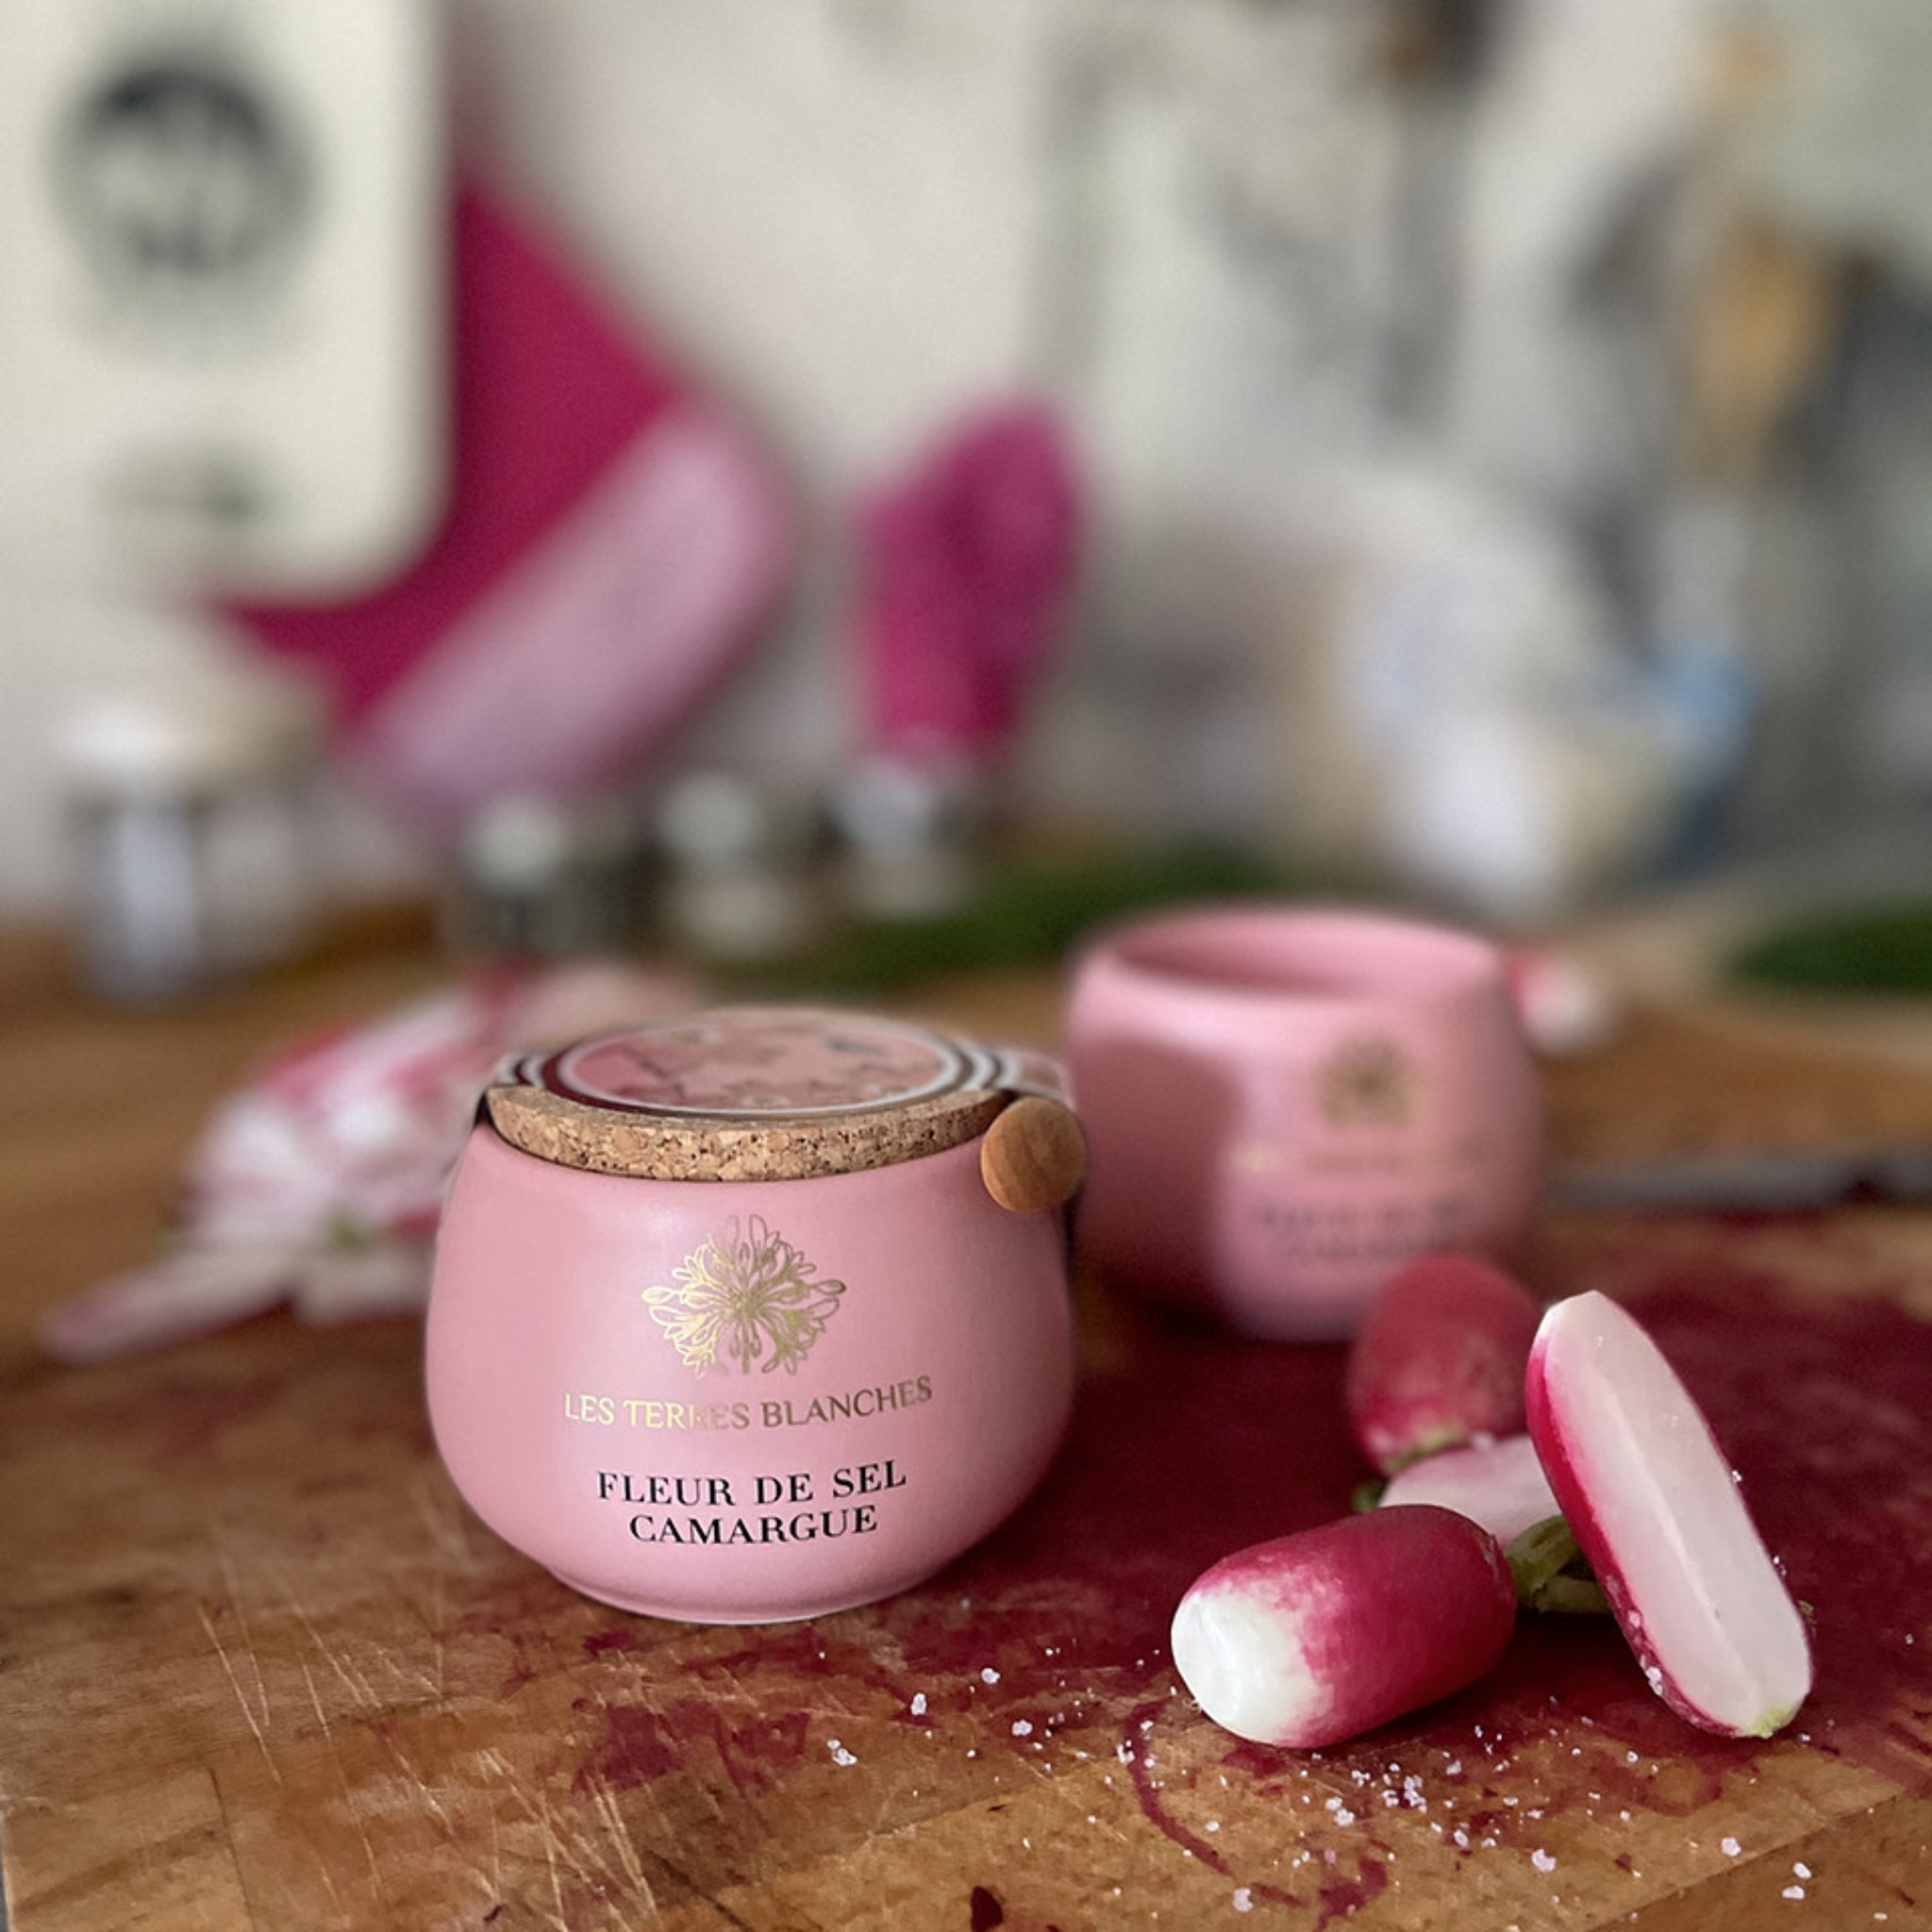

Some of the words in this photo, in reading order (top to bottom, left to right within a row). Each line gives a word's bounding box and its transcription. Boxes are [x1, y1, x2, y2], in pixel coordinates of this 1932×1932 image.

[565, 1392, 614, 1425] LES
[623, 1399, 750, 1429] TERRES
[760, 1376, 933, 1428] BLANCHES
[597, 1471, 736, 1507] FLEUR
[755, 1474, 814, 1505] DE
[831, 1459, 907, 1498] SEL
[629, 1505, 877, 1544] CAMARGUE
